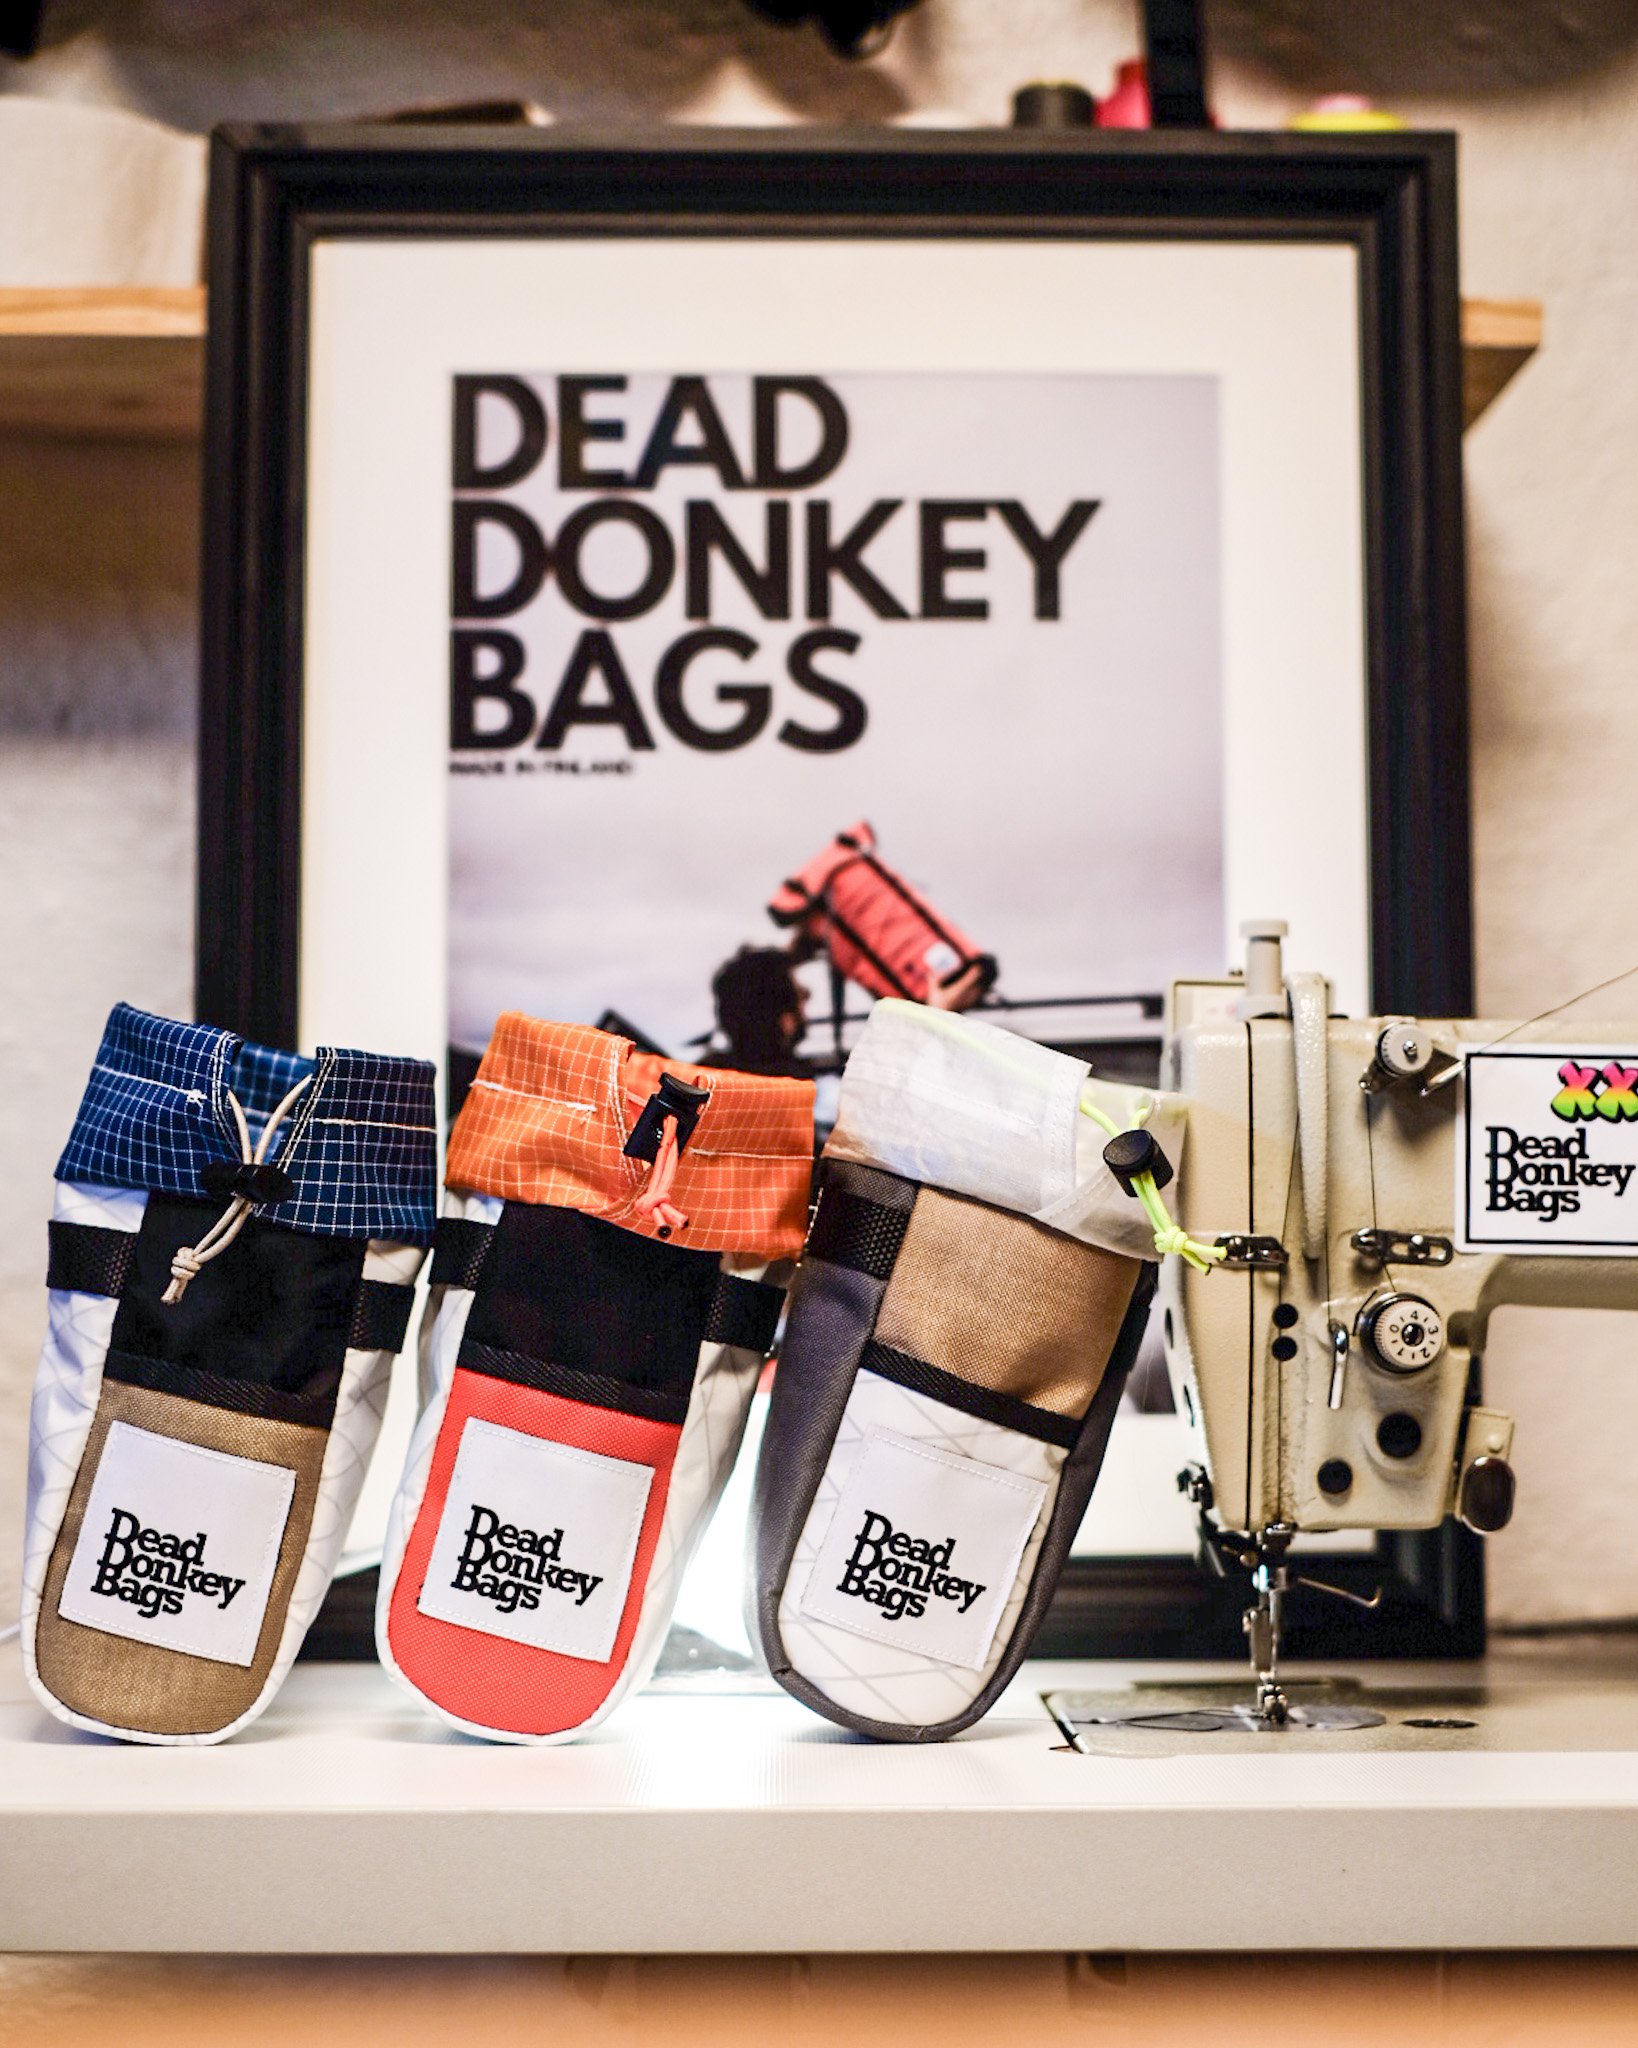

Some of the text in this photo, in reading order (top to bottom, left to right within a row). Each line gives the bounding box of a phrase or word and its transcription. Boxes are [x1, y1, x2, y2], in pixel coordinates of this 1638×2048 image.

[452, 374, 850, 491] DEAD
[451, 498, 1103, 622] DONKEY
[450, 626, 869, 754] BAGS
[1485, 1126, 1590, 1159] Dead
[1485, 1153, 1636, 1197] Donkey
[1485, 1181, 1581, 1222] Bags
[1389, 1324, 1400, 1334] 0
[1410, 1310, 1419, 1320] 4
[1428, 1325, 1439, 1335] 3
[1420, 1347, 1431, 1359] 2
[105, 1508, 207, 1566] Dead
[465, 1504, 565, 1561] Dead
[855, 1509, 957, 1570] Dead
[91, 1560, 185, 1618] Bags
[97, 1533, 246, 1609] Donkey
[451, 1556, 542, 1613] Bags
[457, 1529, 603, 1606] Donkey
[836, 1560, 928, 1620] Bags
[846, 1534, 987, 1613] Donkey
